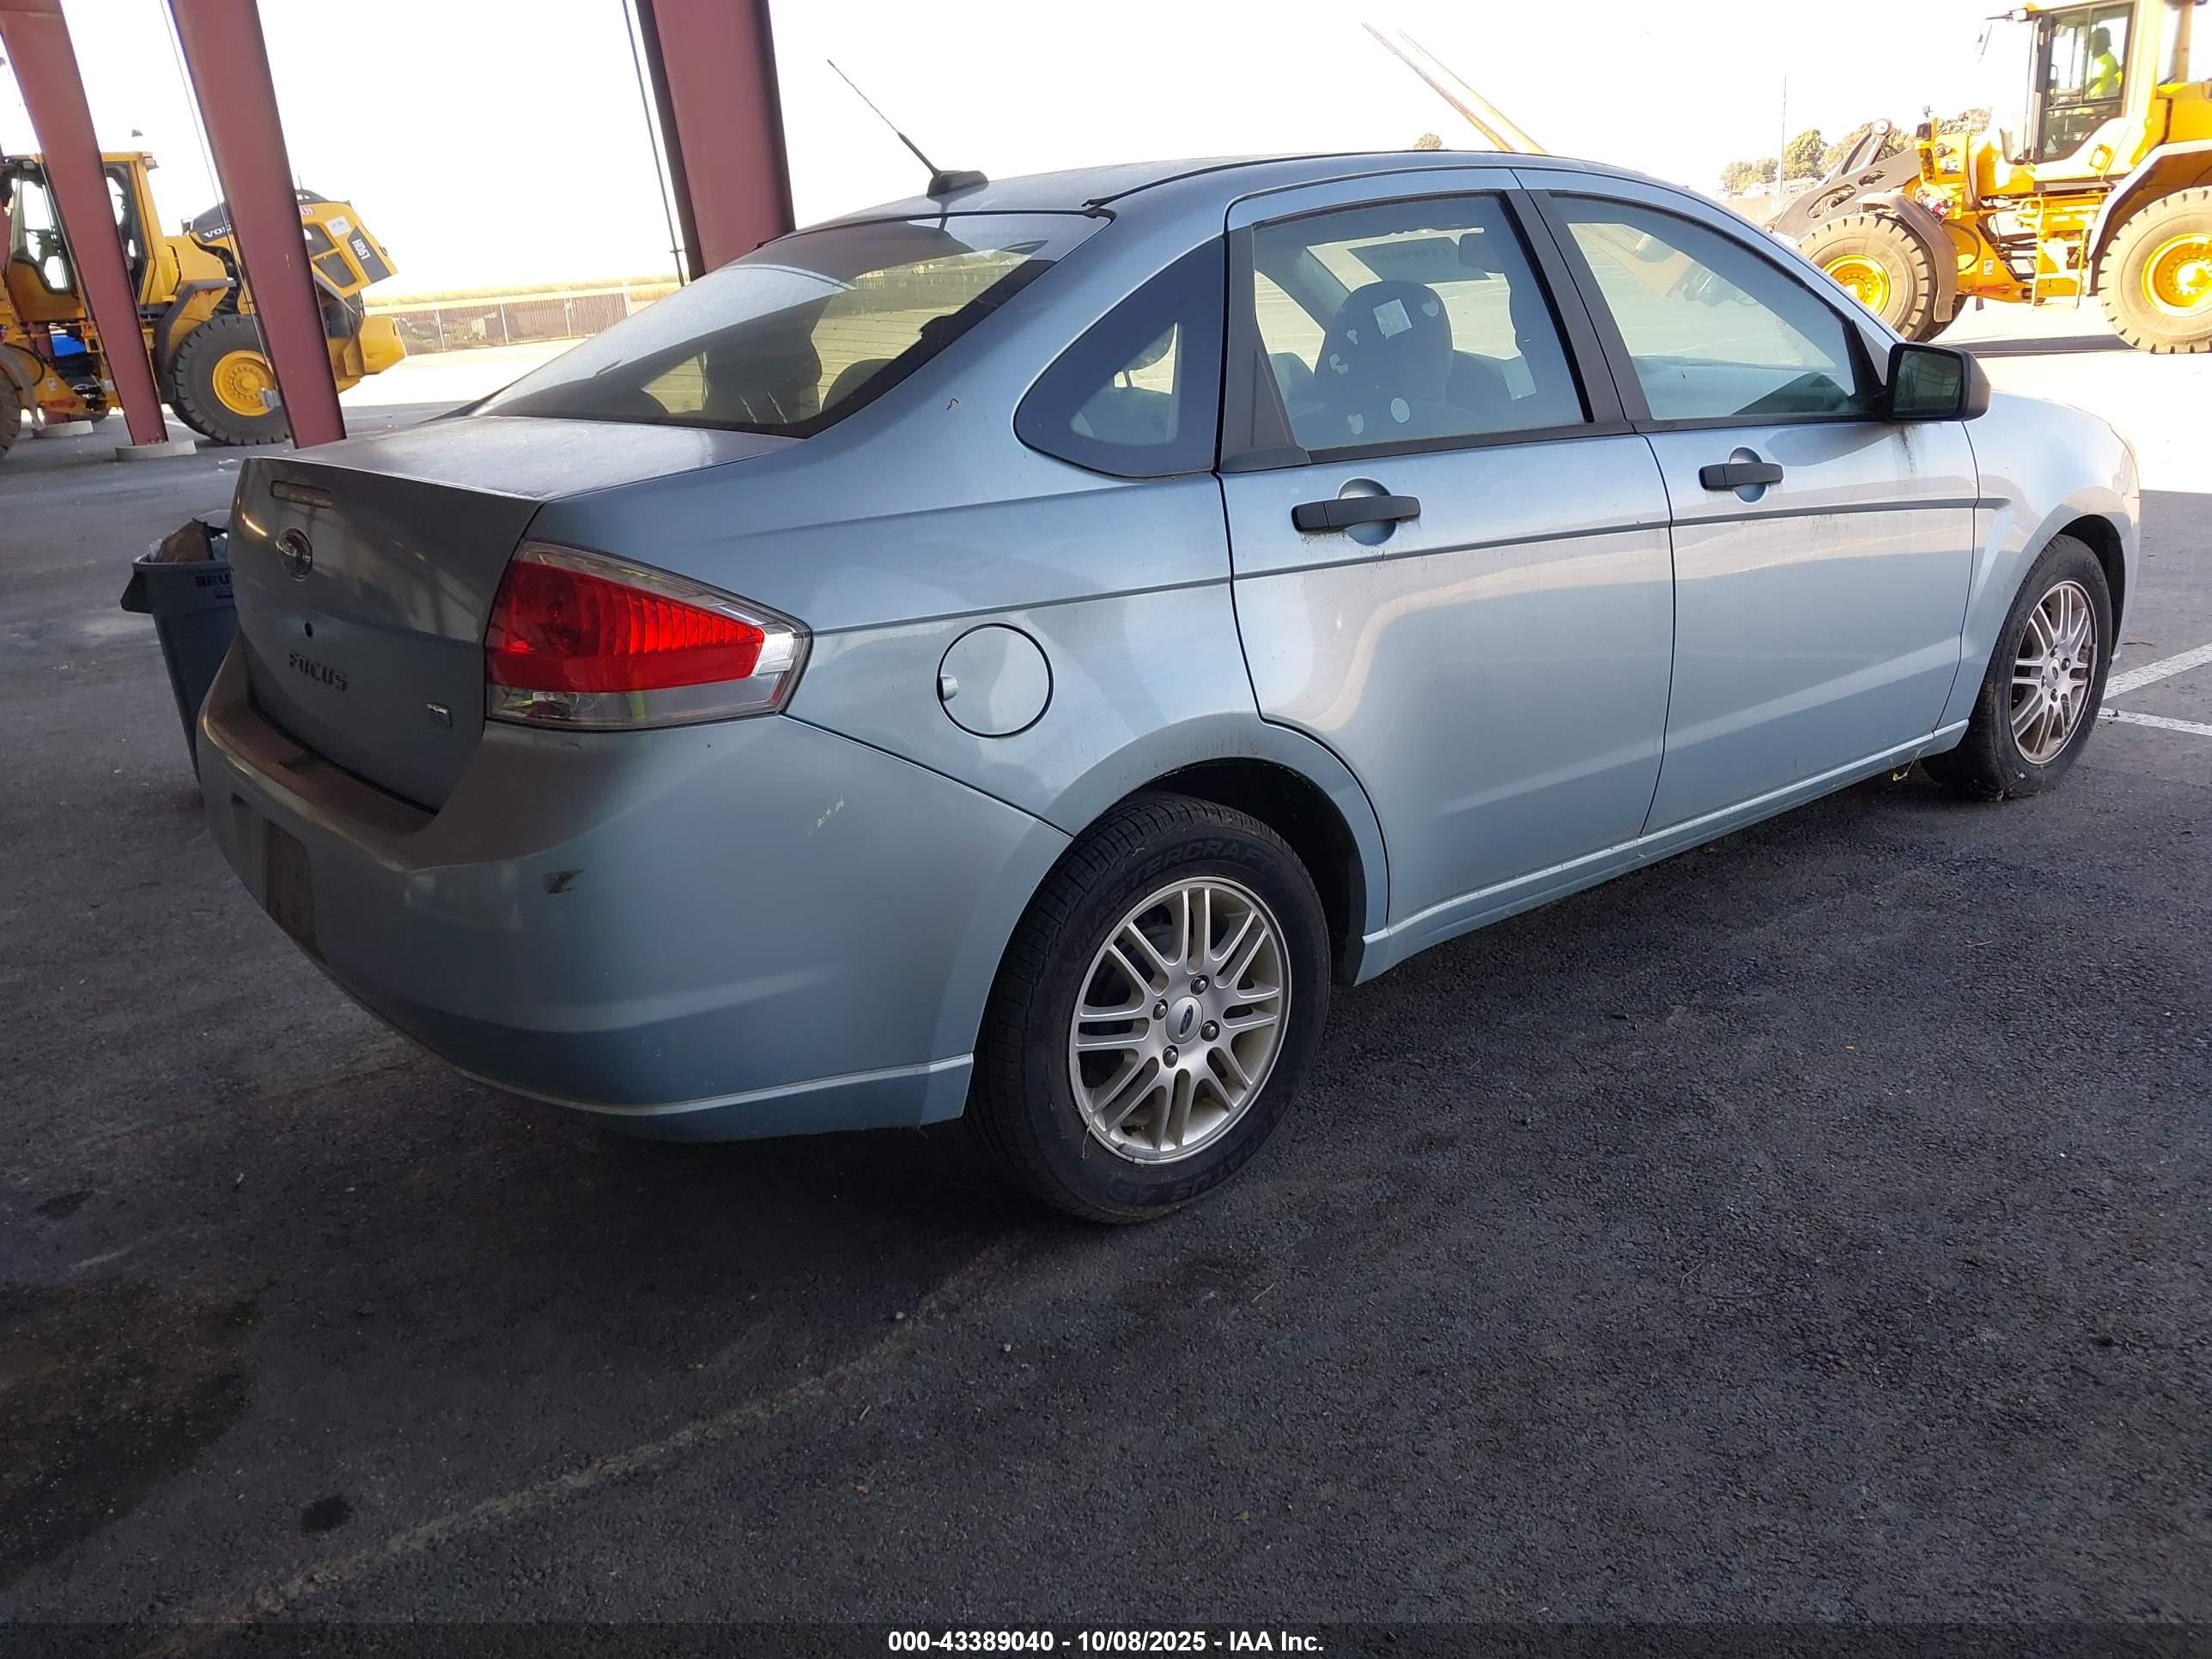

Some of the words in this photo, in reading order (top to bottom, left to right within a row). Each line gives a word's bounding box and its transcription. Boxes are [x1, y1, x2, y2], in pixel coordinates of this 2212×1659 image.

[202, 223, 232, 238] VOL
[352, 239, 371, 260] L90H
[195, 574, 230, 587] BRU
[289, 652, 349, 691] FOCUS
